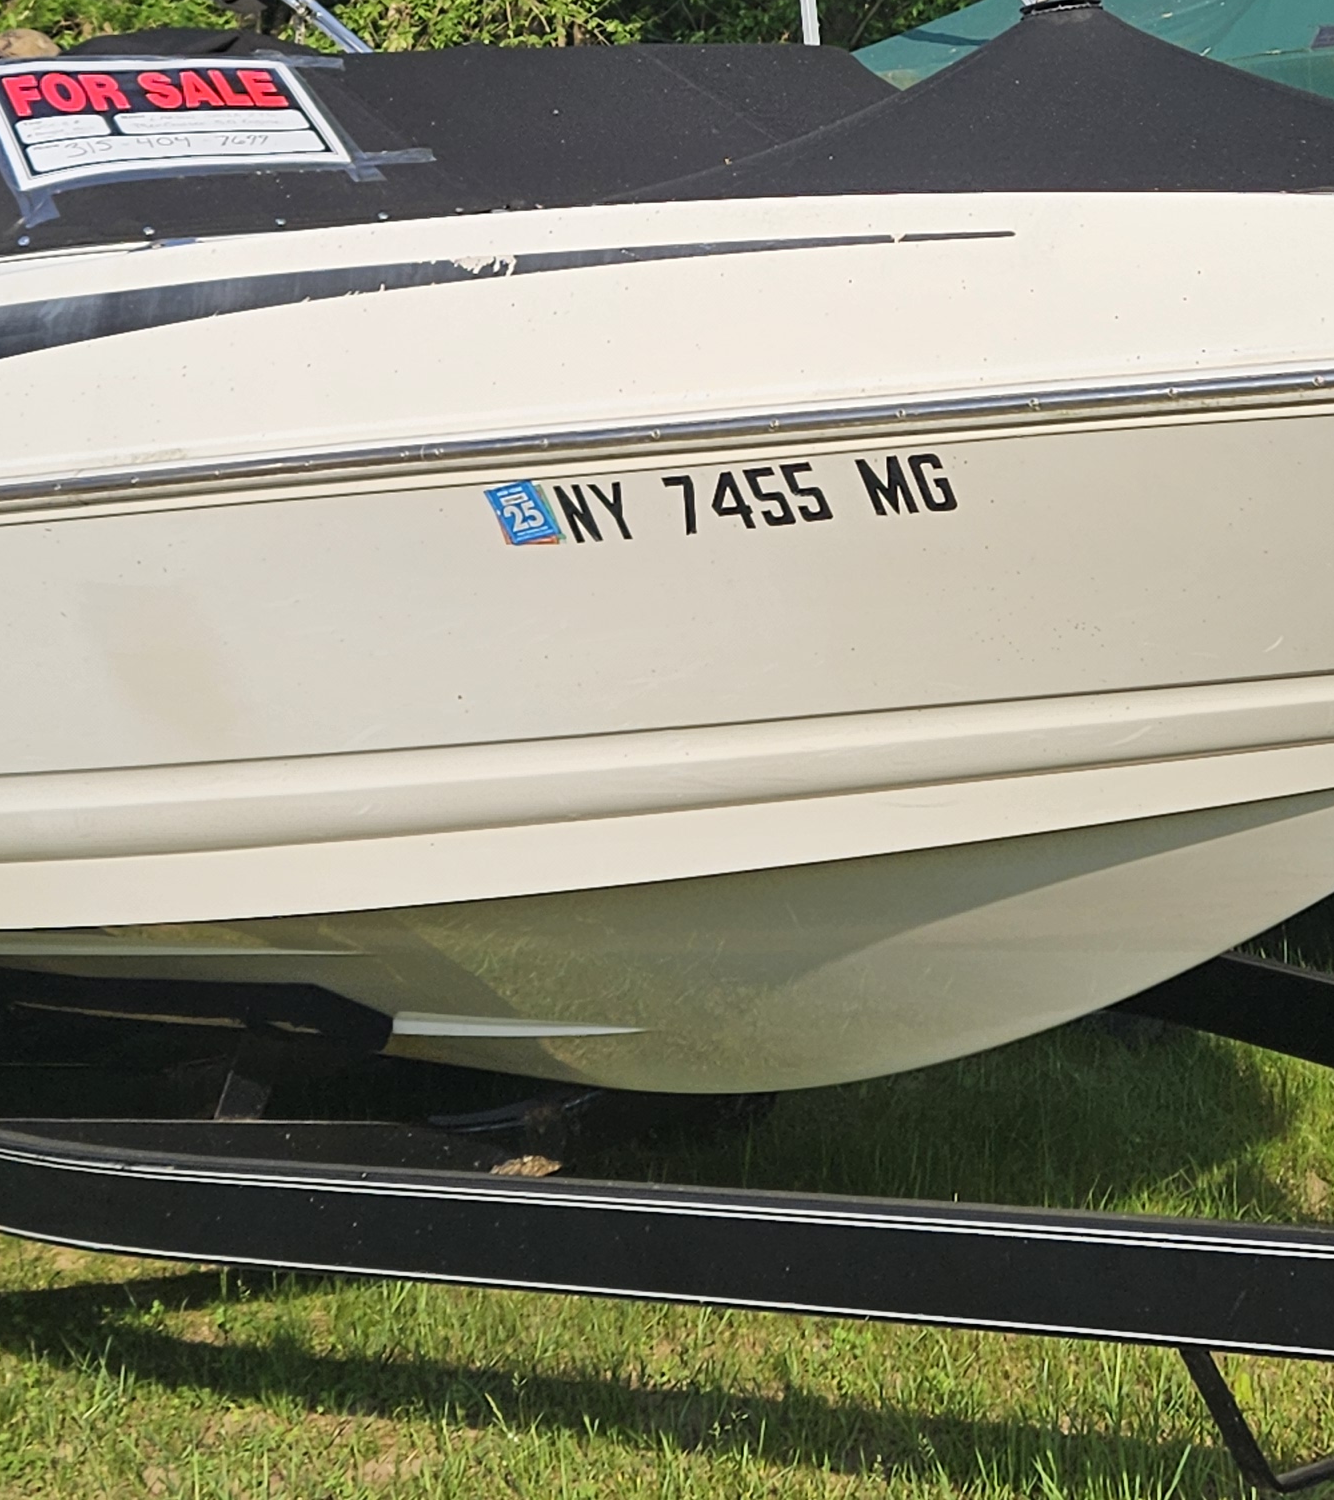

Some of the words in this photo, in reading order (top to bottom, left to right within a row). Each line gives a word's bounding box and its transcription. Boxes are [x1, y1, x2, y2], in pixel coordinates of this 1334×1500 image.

[1, 71, 131, 117] FOR
[137, 69, 289, 109] SALE
[64, 139, 113, 159] 315
[502, 499, 545, 533] 25
[553, 481, 634, 543] NY
[661, 461, 834, 536] 7455
[855, 453, 958, 516] MG
